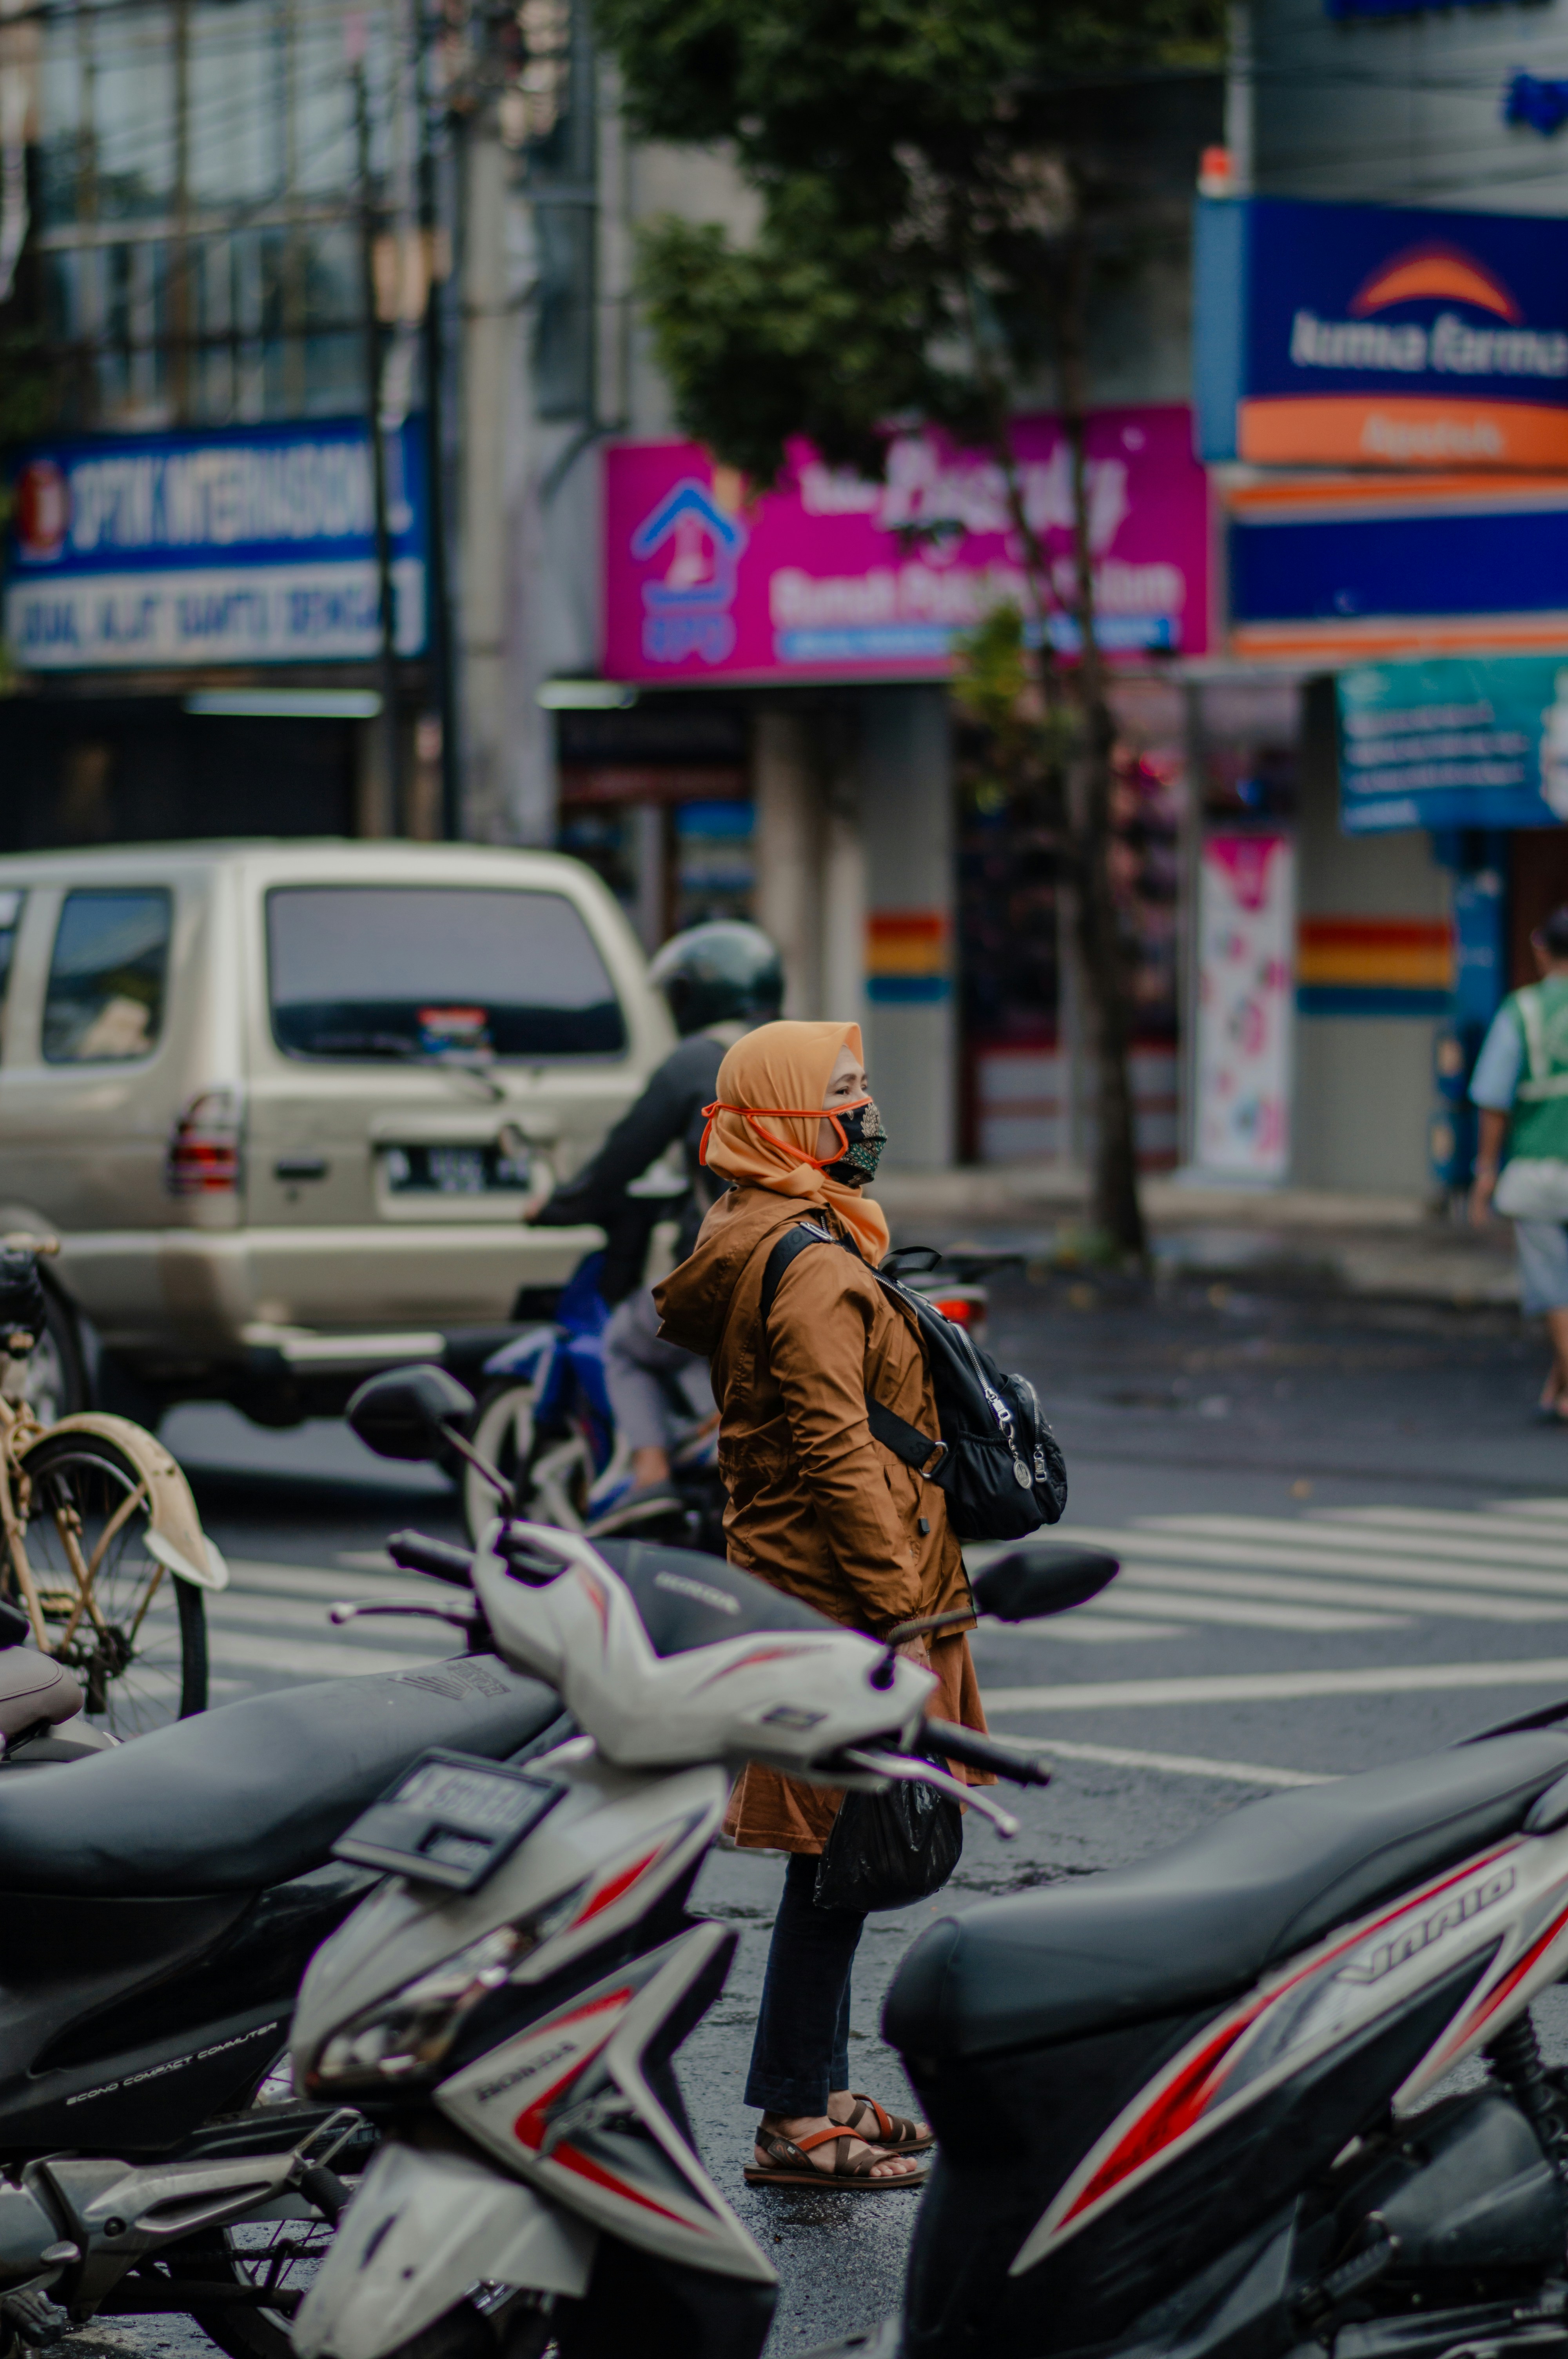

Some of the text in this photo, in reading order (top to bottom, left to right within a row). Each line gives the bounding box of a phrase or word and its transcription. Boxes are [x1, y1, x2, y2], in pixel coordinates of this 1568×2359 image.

[66, 2022, 278, 2105] ECONO COMPACT COMMUTER
